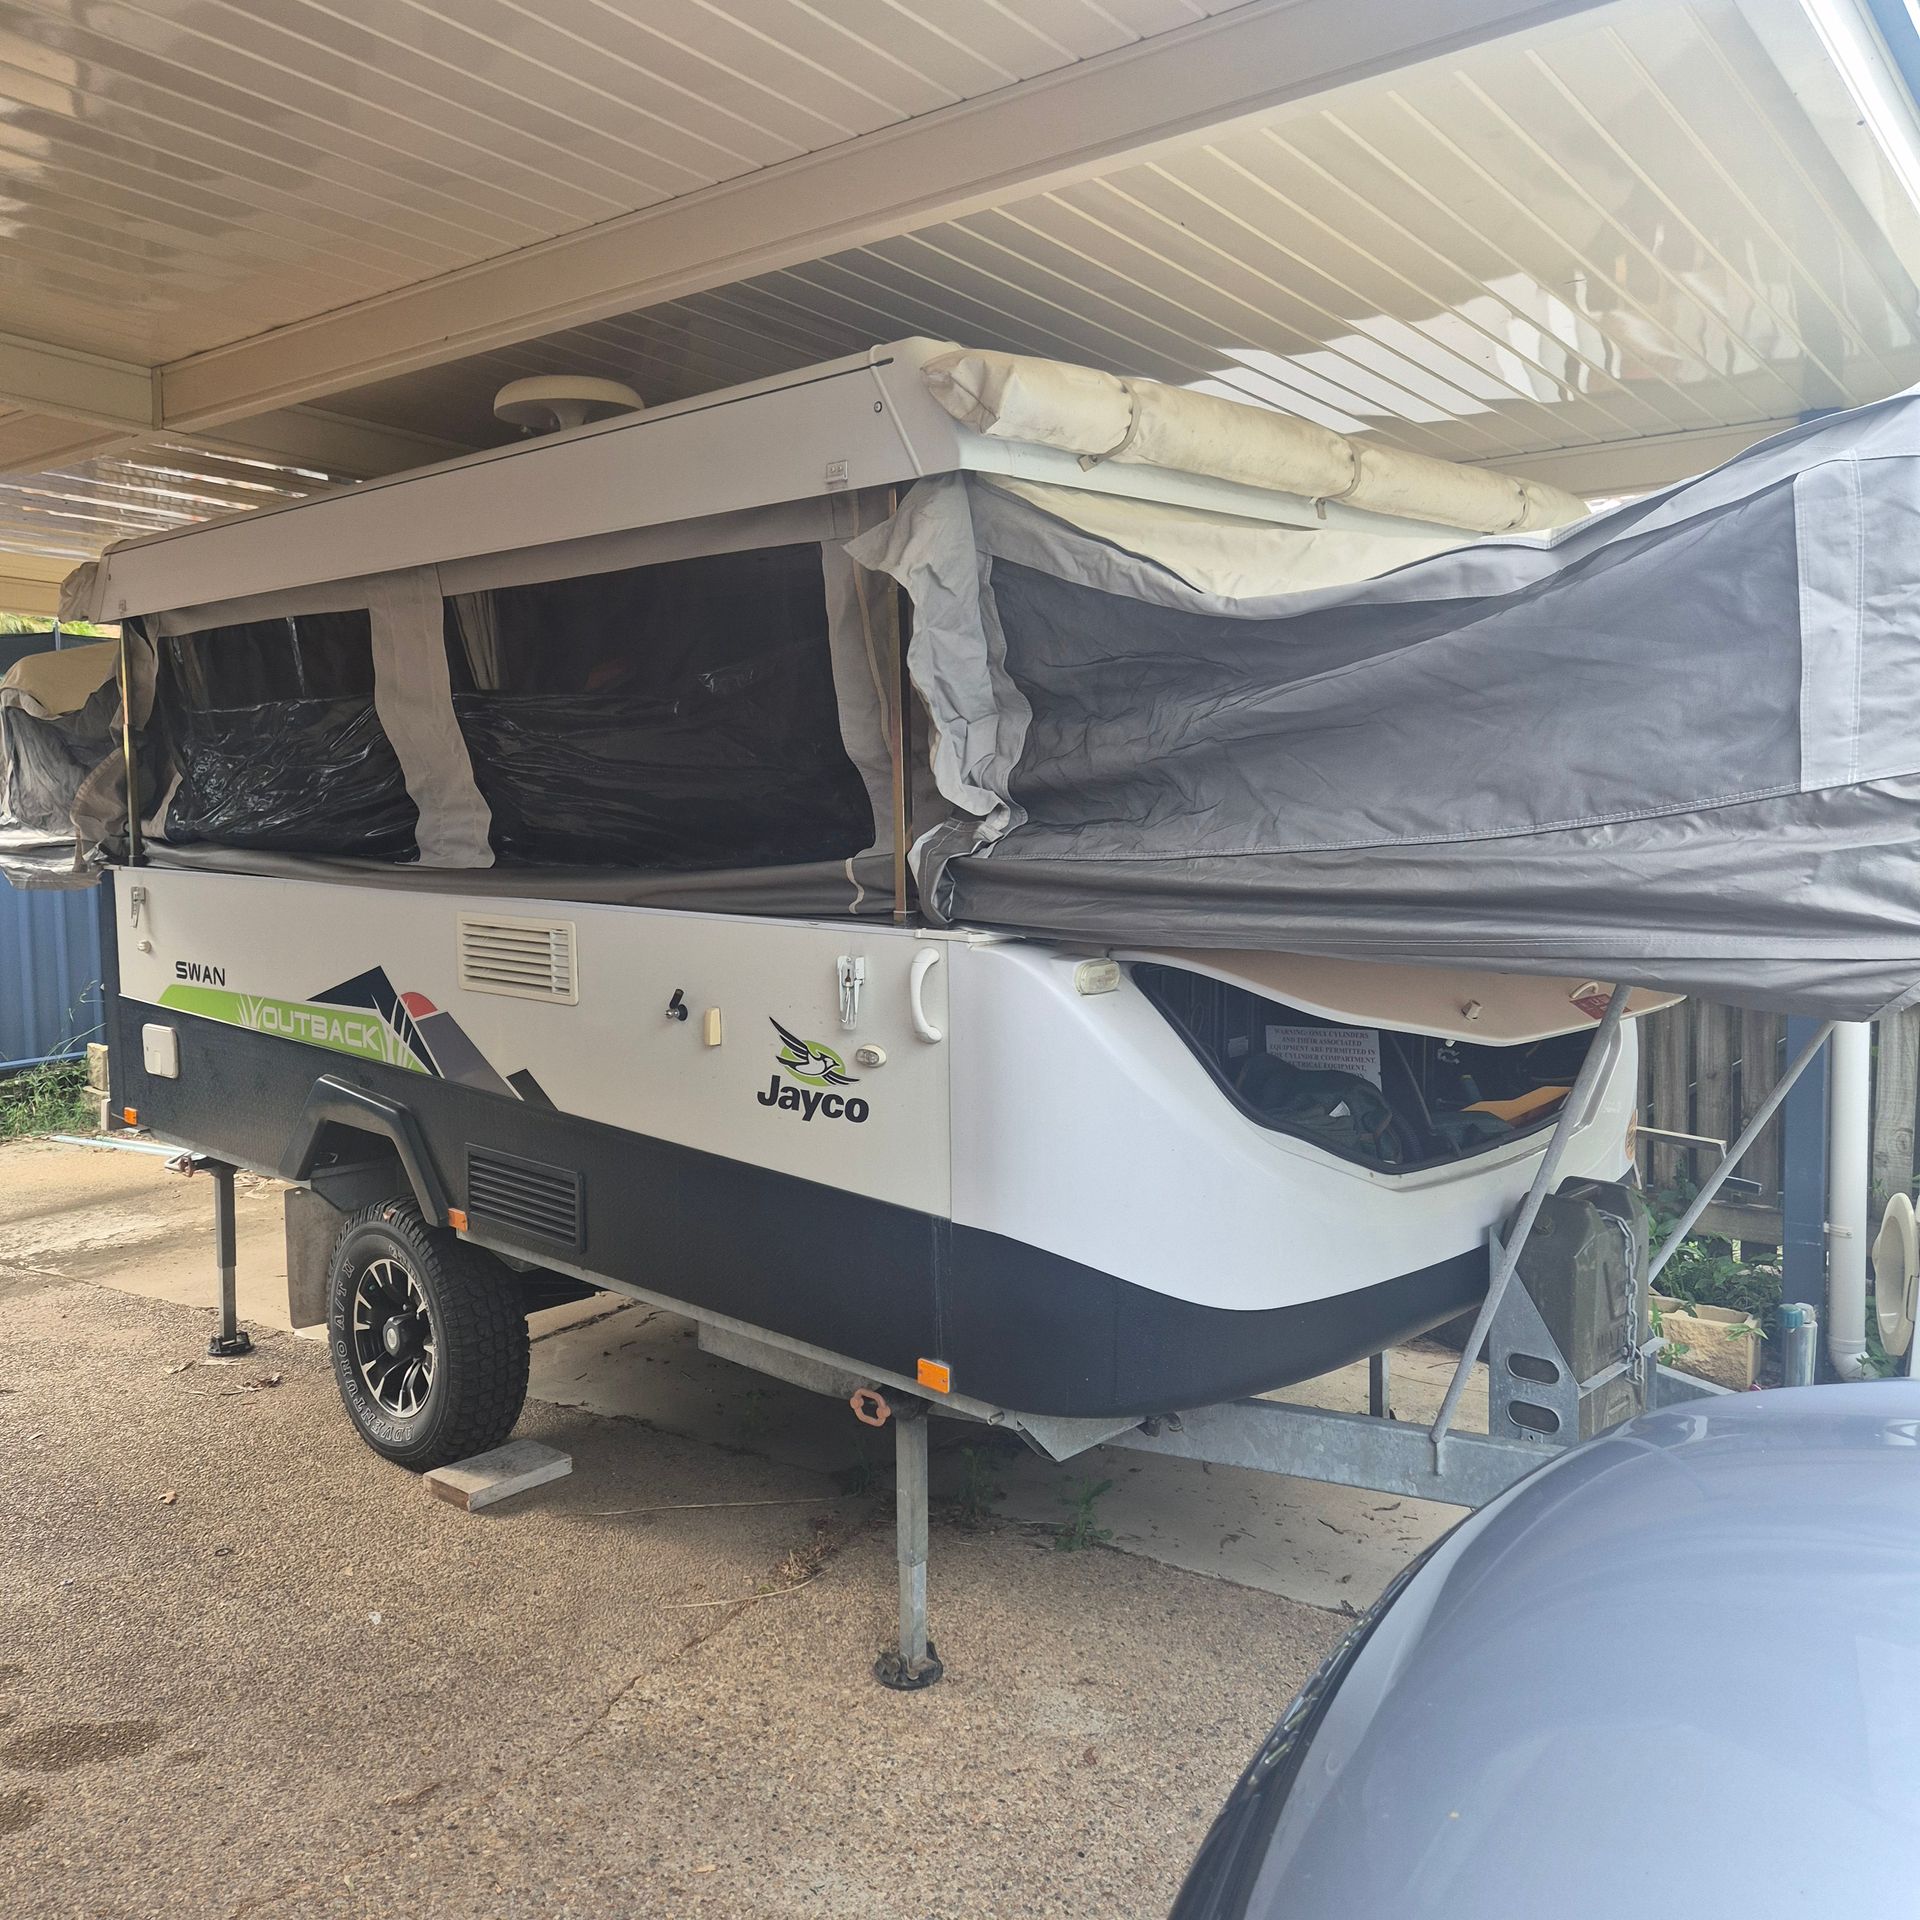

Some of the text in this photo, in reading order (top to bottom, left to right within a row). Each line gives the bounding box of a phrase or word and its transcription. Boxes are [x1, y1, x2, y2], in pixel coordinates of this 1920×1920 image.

[175, 961, 225, 986] SWAN
[262, 1006, 380, 1051] OUTBACK
[1328, 1031, 1369, 1039] CYLINDERS
[1270, 1043, 1376, 1056] EQUIPMENT ARE PERMITTED IN
[1297, 1036, 1317, 1044] THEIR
[1318, 1038, 1362, 1047] ASSOCIATED
[1284, 1053, 1319, 1062] CYLINDER
[1320, 1054, 1376, 1064] COMPARTMENT
[757, 1074, 869, 1123] Jayco
[334, 1280, 347, 1331] A/T
[336, 1340, 414, 1442] ADVENTURO
